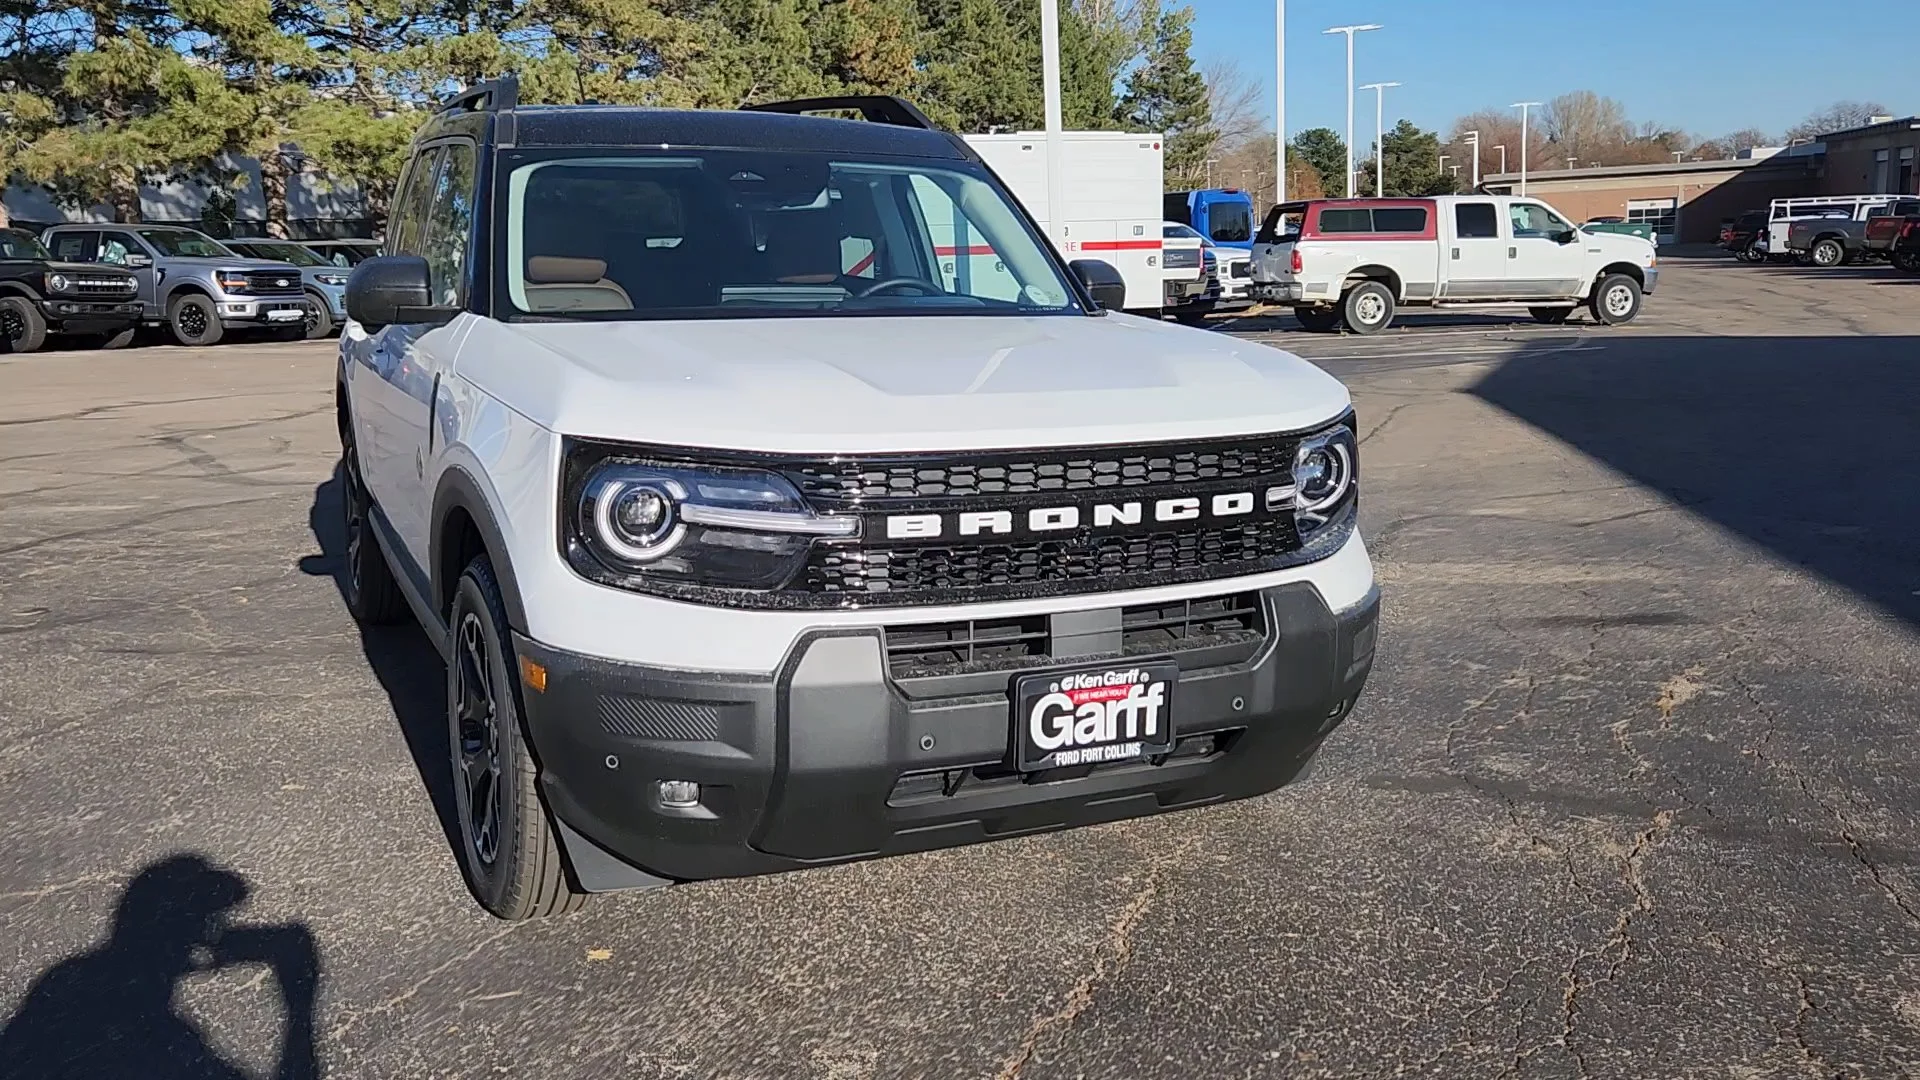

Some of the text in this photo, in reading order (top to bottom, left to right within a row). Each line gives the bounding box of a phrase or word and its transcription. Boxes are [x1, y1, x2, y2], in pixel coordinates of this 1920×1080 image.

[886, 492, 1255, 539] BRONCO
[1074, 674, 1103, 689] Ken
[1103, 668, 1140, 685] Garff
[1030, 681, 1165, 750] Garff
[1056, 742, 1141, 766] FORD FORT COLLINS
